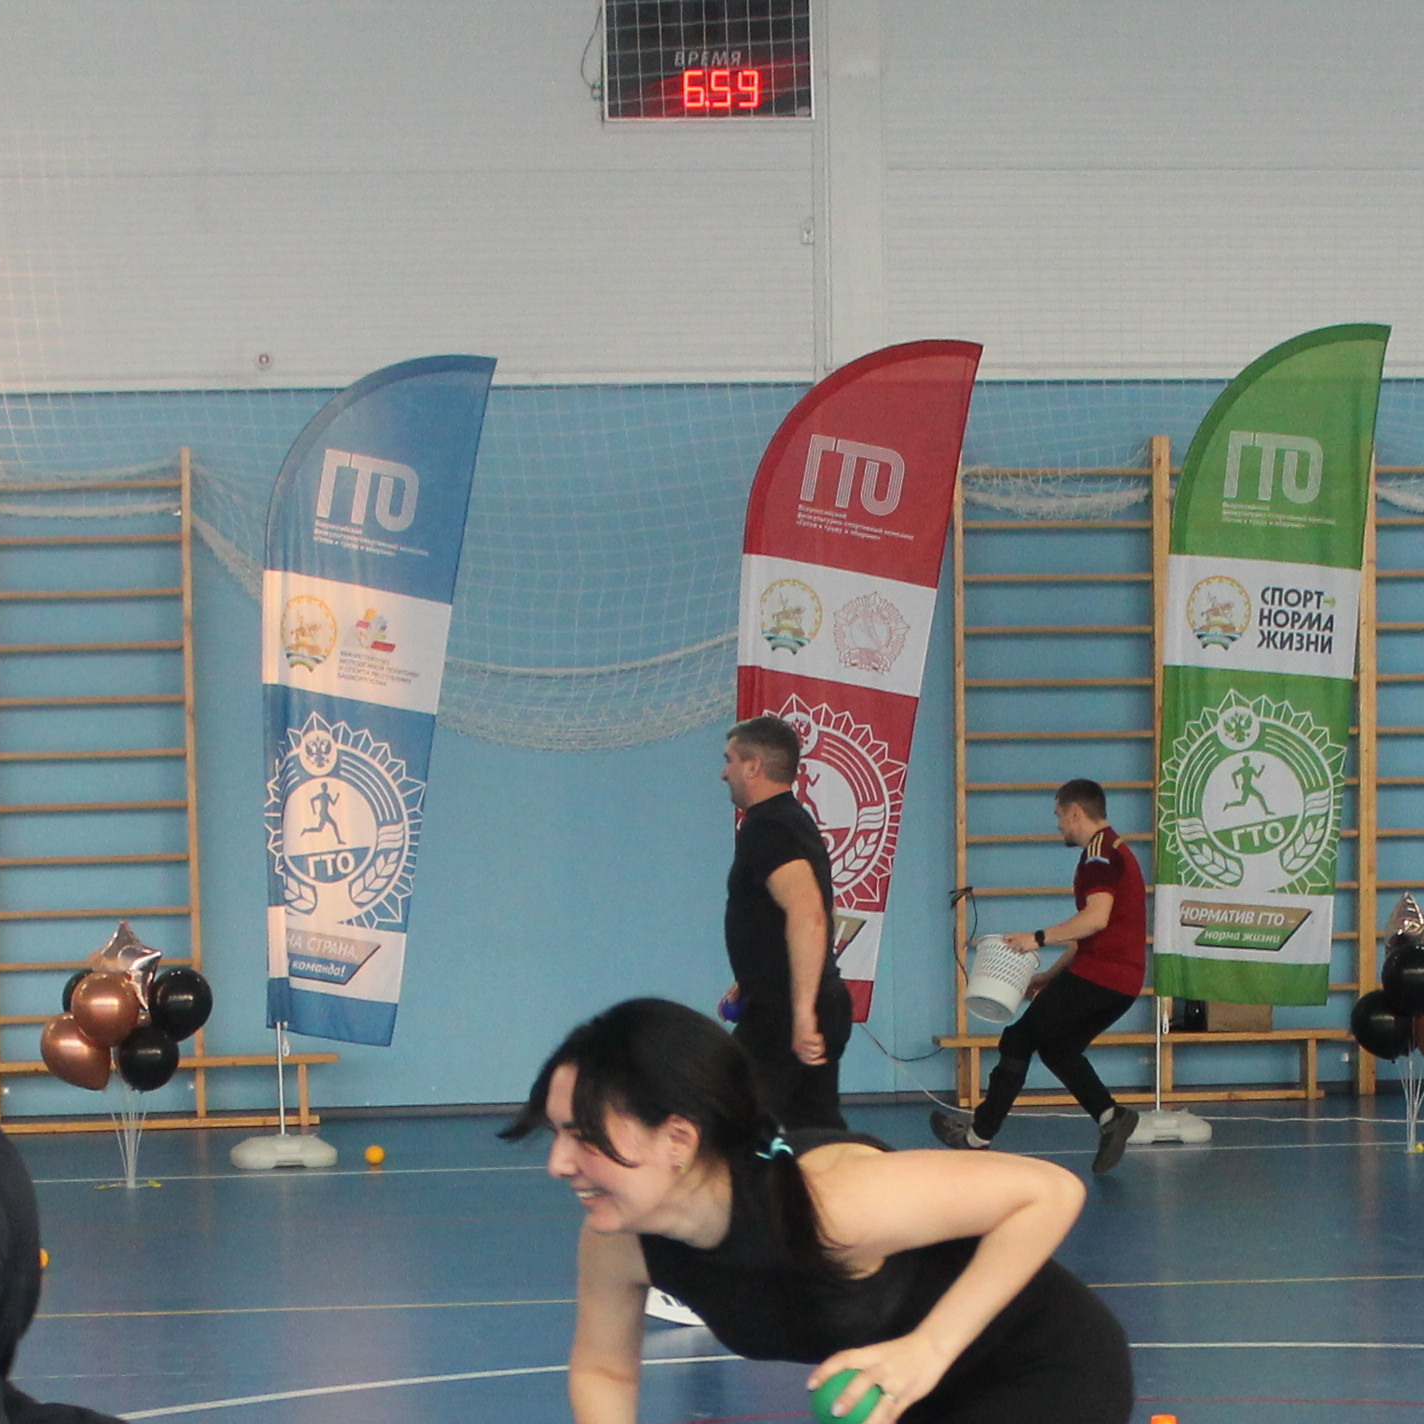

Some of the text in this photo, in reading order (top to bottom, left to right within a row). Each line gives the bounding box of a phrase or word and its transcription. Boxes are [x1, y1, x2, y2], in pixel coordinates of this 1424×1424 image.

[674, 50, 742, 67] ВРЕМЯ
[1260, 586, 1325, 610] СПОРТ
[1258, 607, 1334, 633] НОРМА
[1257, 629, 1333, 655] ЖИЗНИ
[1231, 821, 1285, 851] ГТО
[307, 851, 356, 878] ГТО
[1180, 905, 1255, 925] НОРМАТИВ
[1256, 911, 1285, 926] ГТО
[1204, 930, 1280, 944] норма жизни
[292, 959, 347, 978] команда!
